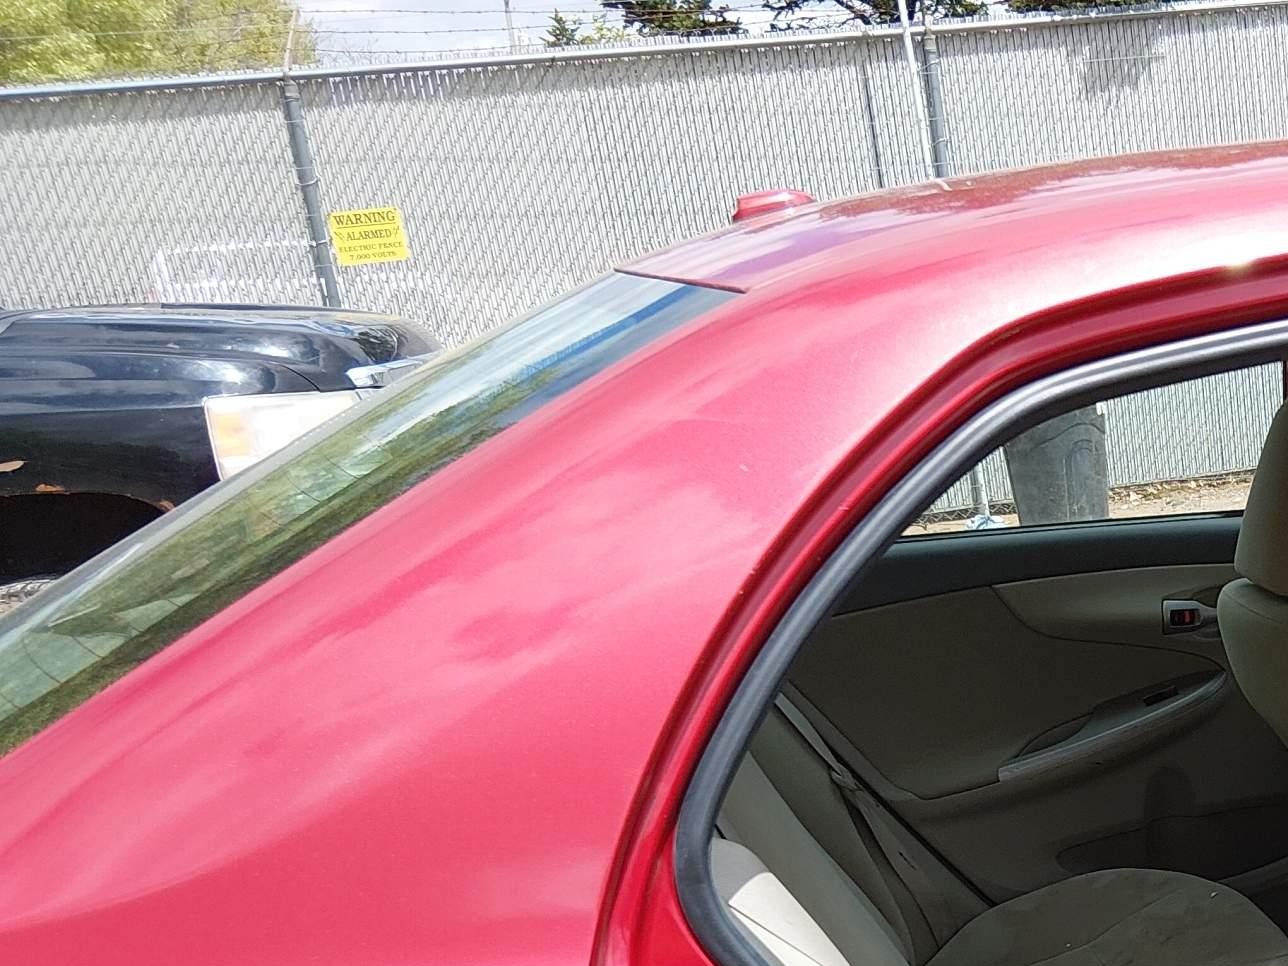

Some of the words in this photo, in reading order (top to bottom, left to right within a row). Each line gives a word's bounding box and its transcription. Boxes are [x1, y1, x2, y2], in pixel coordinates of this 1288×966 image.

[333, 210, 396, 225] WARNING
[346, 228, 392, 241] ALARMED
[339, 243, 377, 253] ELECTRIC
[378, 241, 403, 250] FENCE
[372, 250, 396, 259] VOLTS
